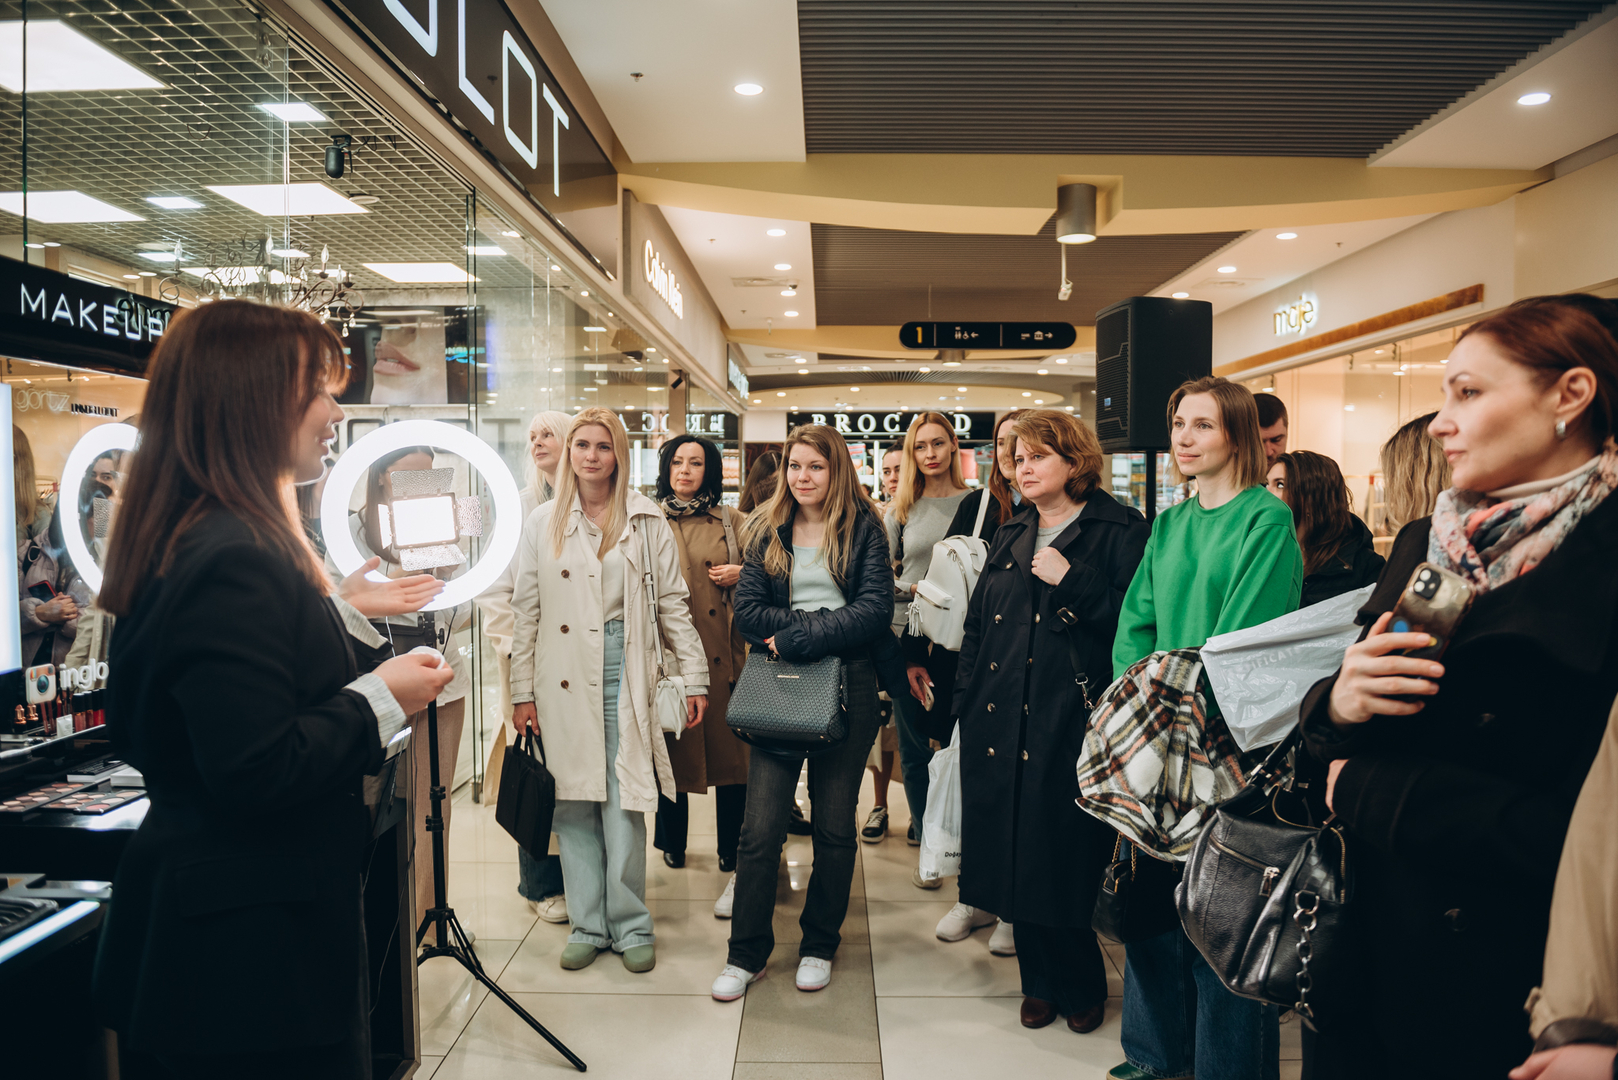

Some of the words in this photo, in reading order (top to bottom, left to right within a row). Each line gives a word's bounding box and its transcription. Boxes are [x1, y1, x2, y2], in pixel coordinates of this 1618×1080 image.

[1273, 295, 1314, 335] maje
[915, 326, 923, 344] 1
[812, 413, 971, 432] BROCD
